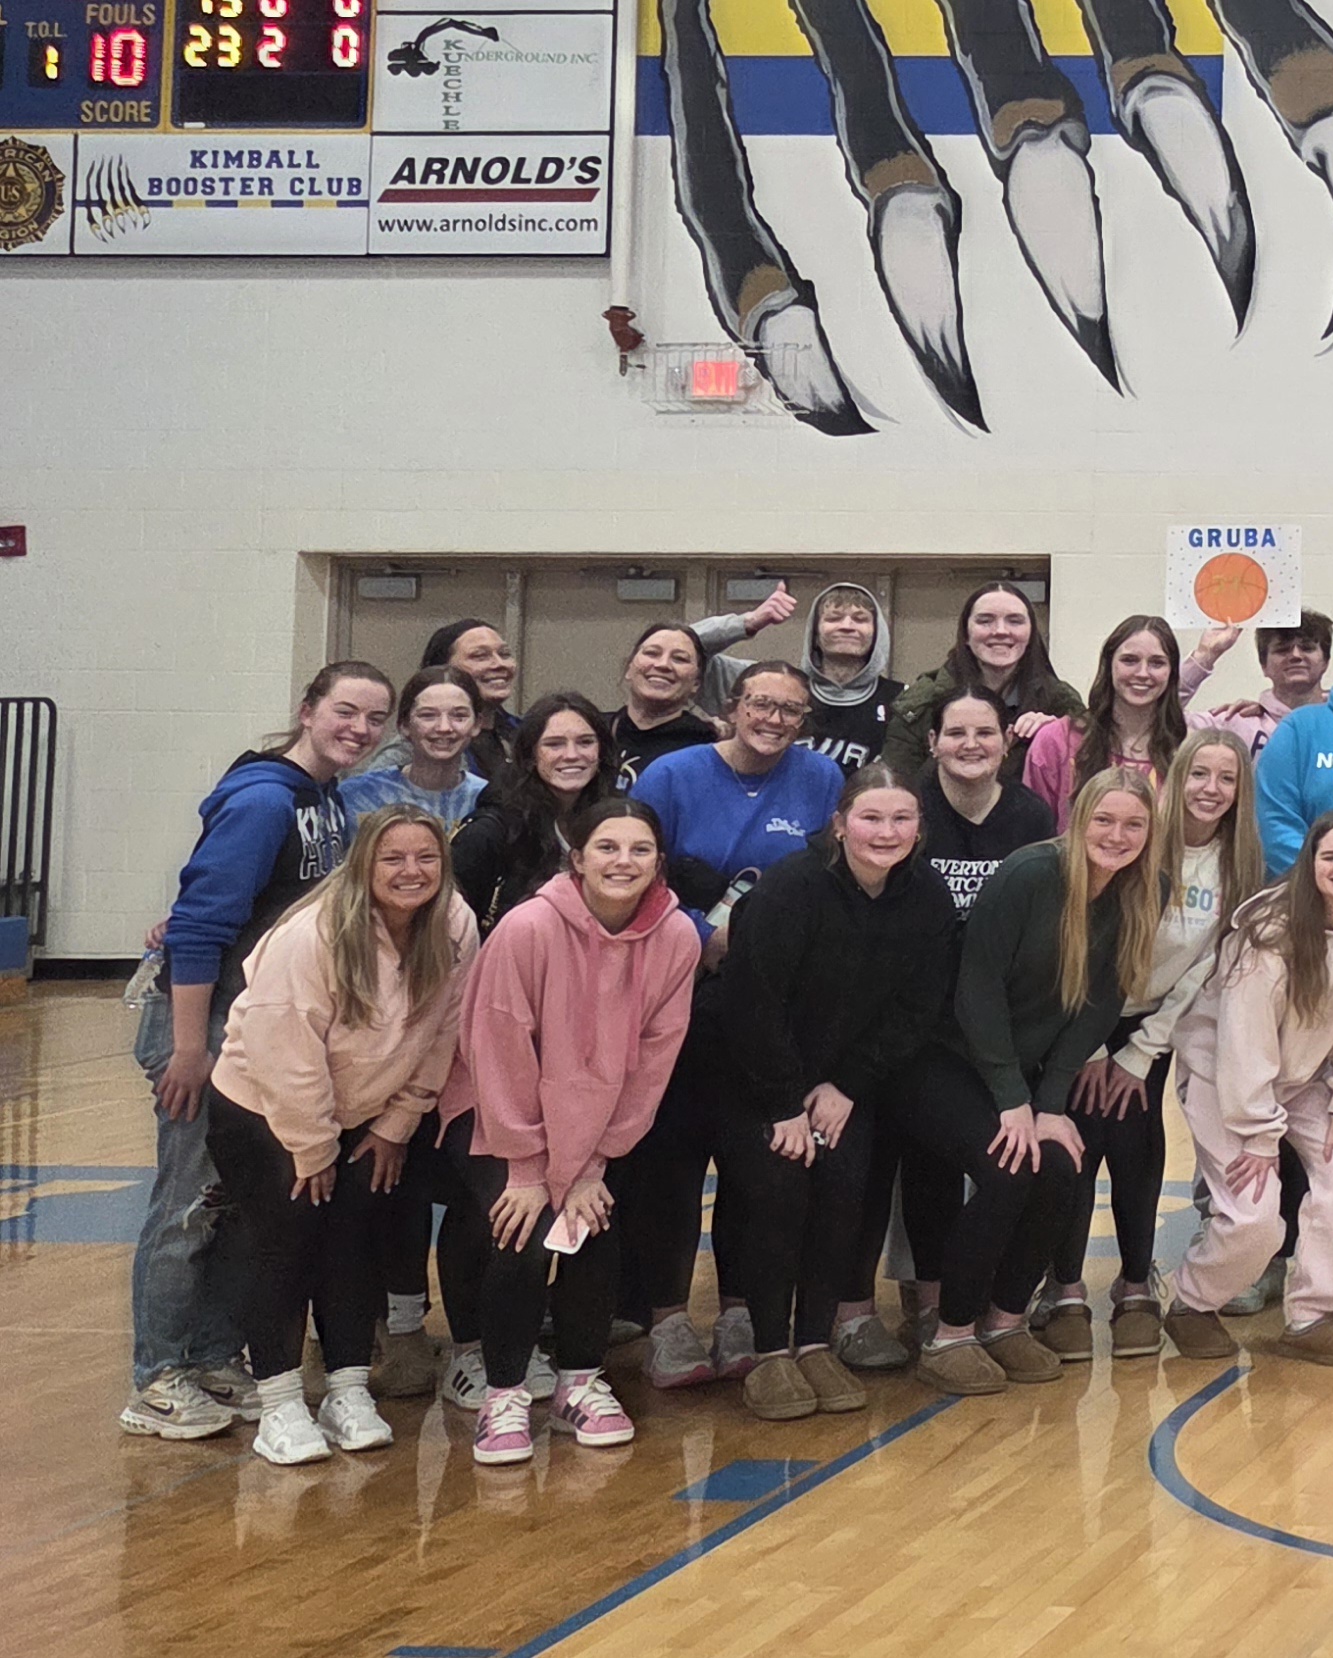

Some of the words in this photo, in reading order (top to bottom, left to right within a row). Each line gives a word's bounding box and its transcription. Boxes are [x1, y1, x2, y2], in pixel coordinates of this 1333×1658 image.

[86, 4, 155, 25] FOULS
[184, 24, 241, 67] 23
[91, 29, 145, 86] 10
[81, 101, 151, 123] SCORE
[0, 148, 53, 183] RICAN
[190, 150, 320, 169] KIMBALL
[390, 156, 601, 185] ARNOLD'S
[147, 177, 275, 196] BOOSTER
[289, 177, 362, 196] CLUB
[0, 220, 39, 240] GION
[377, 213, 599, 237] www.arnoldsinc.com
[1188, 528, 1276, 548] GRUBA
